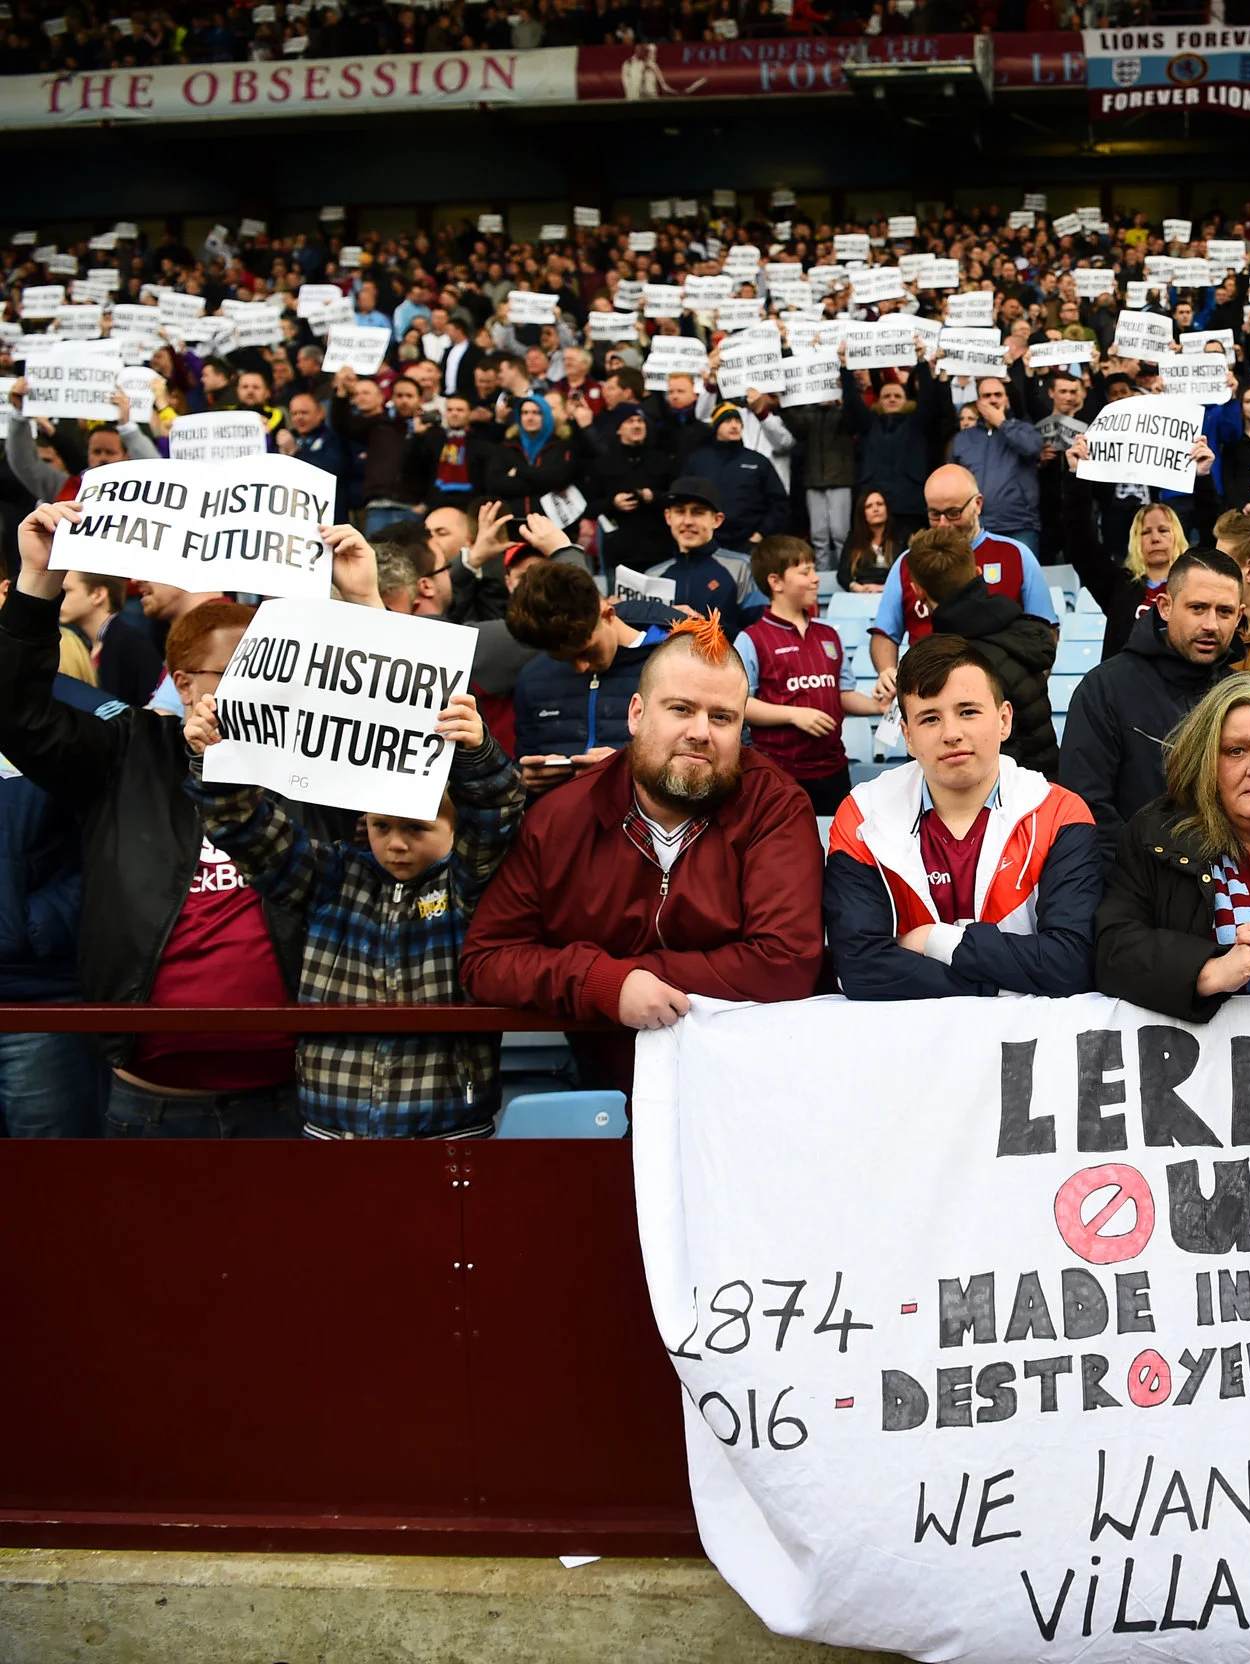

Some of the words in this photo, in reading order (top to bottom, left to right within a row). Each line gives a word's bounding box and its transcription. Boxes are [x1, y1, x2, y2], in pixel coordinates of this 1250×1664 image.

[681, 41, 828, 64] FOUNDERS
[887, 37, 940, 57] THE
[1100, 32, 1164, 51] LIONS
[42, 74, 155, 114] THE
[182, 55, 518, 107] OBSESSION
[1101, 86, 1200, 113] FOREVER
[1092, 413, 1132, 432] PROUD
[1135, 413, 1200, 443] HISTORY
[1086, 441, 1124, 463] WHAT
[1128, 442, 1193, 473] FUTURE?
[80, 480, 188, 511] PROUD
[200, 482, 330, 524] HISTORY
[69, 514, 172, 551] WHAT
[181, 528, 325, 572] FUTURE?
[225, 636, 301, 684] PROUD
[303, 642, 464, 711] HISTORY
[786, 673, 836, 692] acorn
[213, 697, 290, 749] WHAT
[292, 708, 446, 777] FUTURE?
[666, 1271, 873, 1361] 1874
[939, 1267, 1156, 1348] MADE
[680, 1380, 808, 1450] 016
[914, 1469, 1022, 1548] WE
